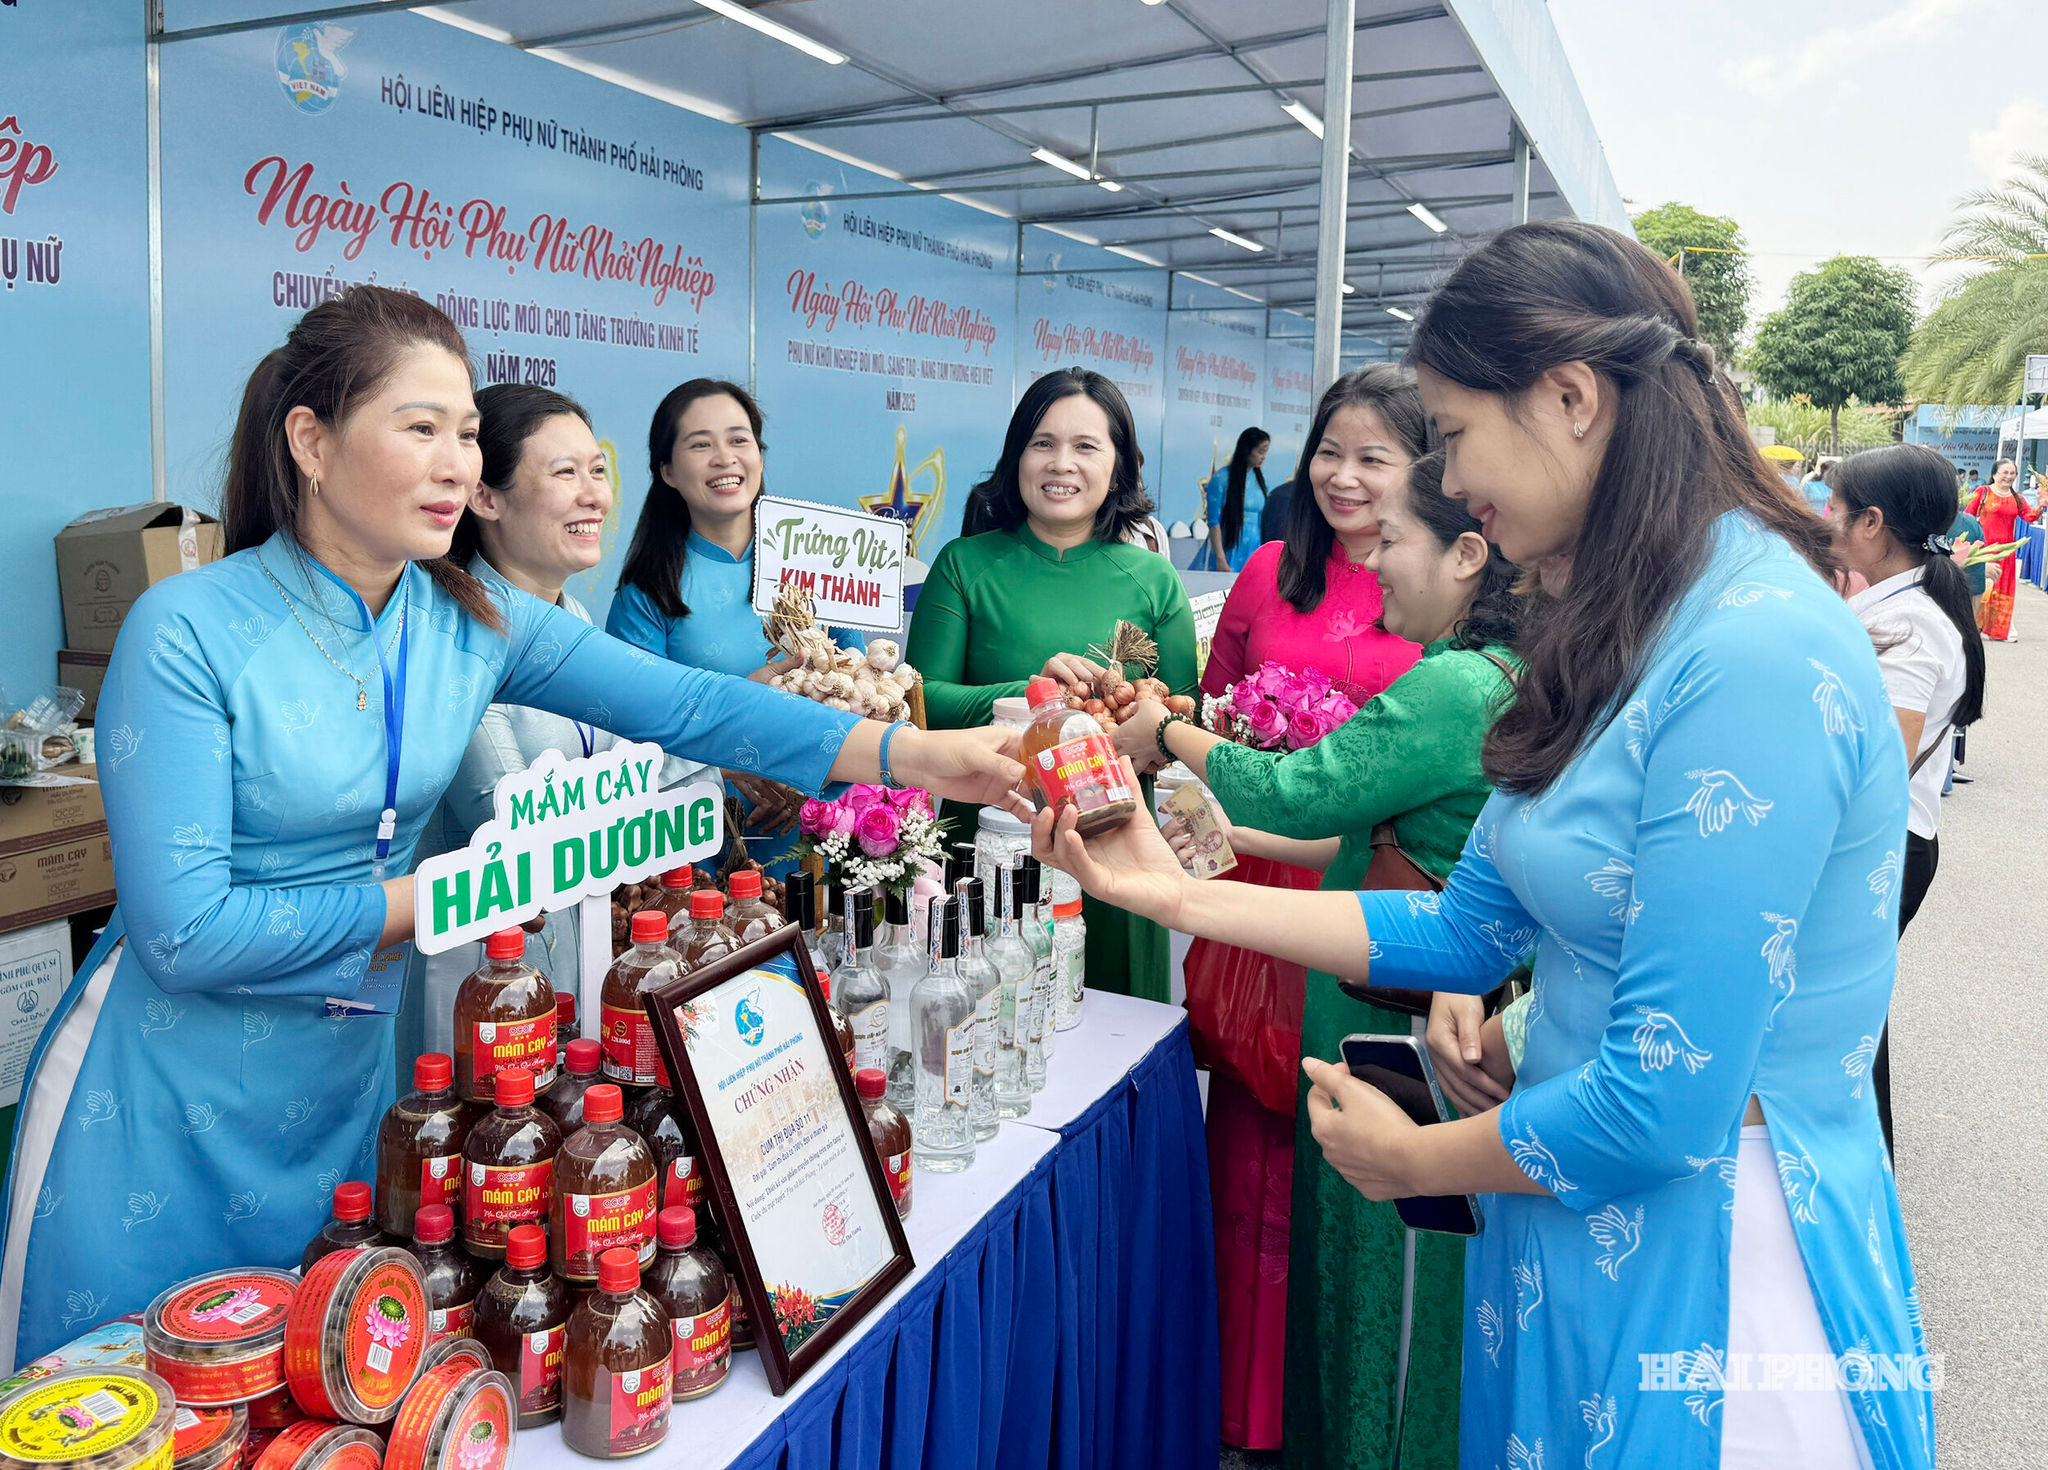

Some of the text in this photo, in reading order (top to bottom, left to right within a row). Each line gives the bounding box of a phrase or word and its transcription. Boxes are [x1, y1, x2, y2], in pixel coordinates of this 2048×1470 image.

[381, 73, 704, 192] HỘI LIÊN HIỆP PHỤ NỮ THÀNH PHỐ HẢI PHÒNG
[26, 236, 63, 285] NỮ
[244, 156, 716, 315] Ngày Hội Phụ Nữ Khởi Nghiệp
[483, 297, 510, 336] LỰC
[514, 299, 541, 335] MỚI
[545, 307, 571, 338] CHO
[575, 309, 607, 343] TĂNG
[609, 311, 655, 349] TRƯỞNG
[657, 323, 684, 352] KINH
[687, 320, 699, 354] TẾ
[786, 269, 842, 334] Ngày
[841, 280, 873, 331] Hội
[875, 287, 907, 337] Phụ
[487, 348, 557, 387] NĂM 2026
[775, 517, 888, 575] Trứng Vịt
[779, 567, 881, 608] KIM THÀNH
[510, 758, 653, 830] MẮM CÁY
[432, 797, 714, 936] HẢI DƯƠNG
[527, 1035, 547, 1053] CÁY
[734, 1057, 805, 1114] CHỨNG NHẬN
[782, 1123, 797, 1139] ĐUA
[795, 1114, 804, 1131] SỐ
[803, 1112, 812, 1125] 11
[517, 1186, 540, 1203] CÁY
[623, 1208, 644, 1228] CÁY
